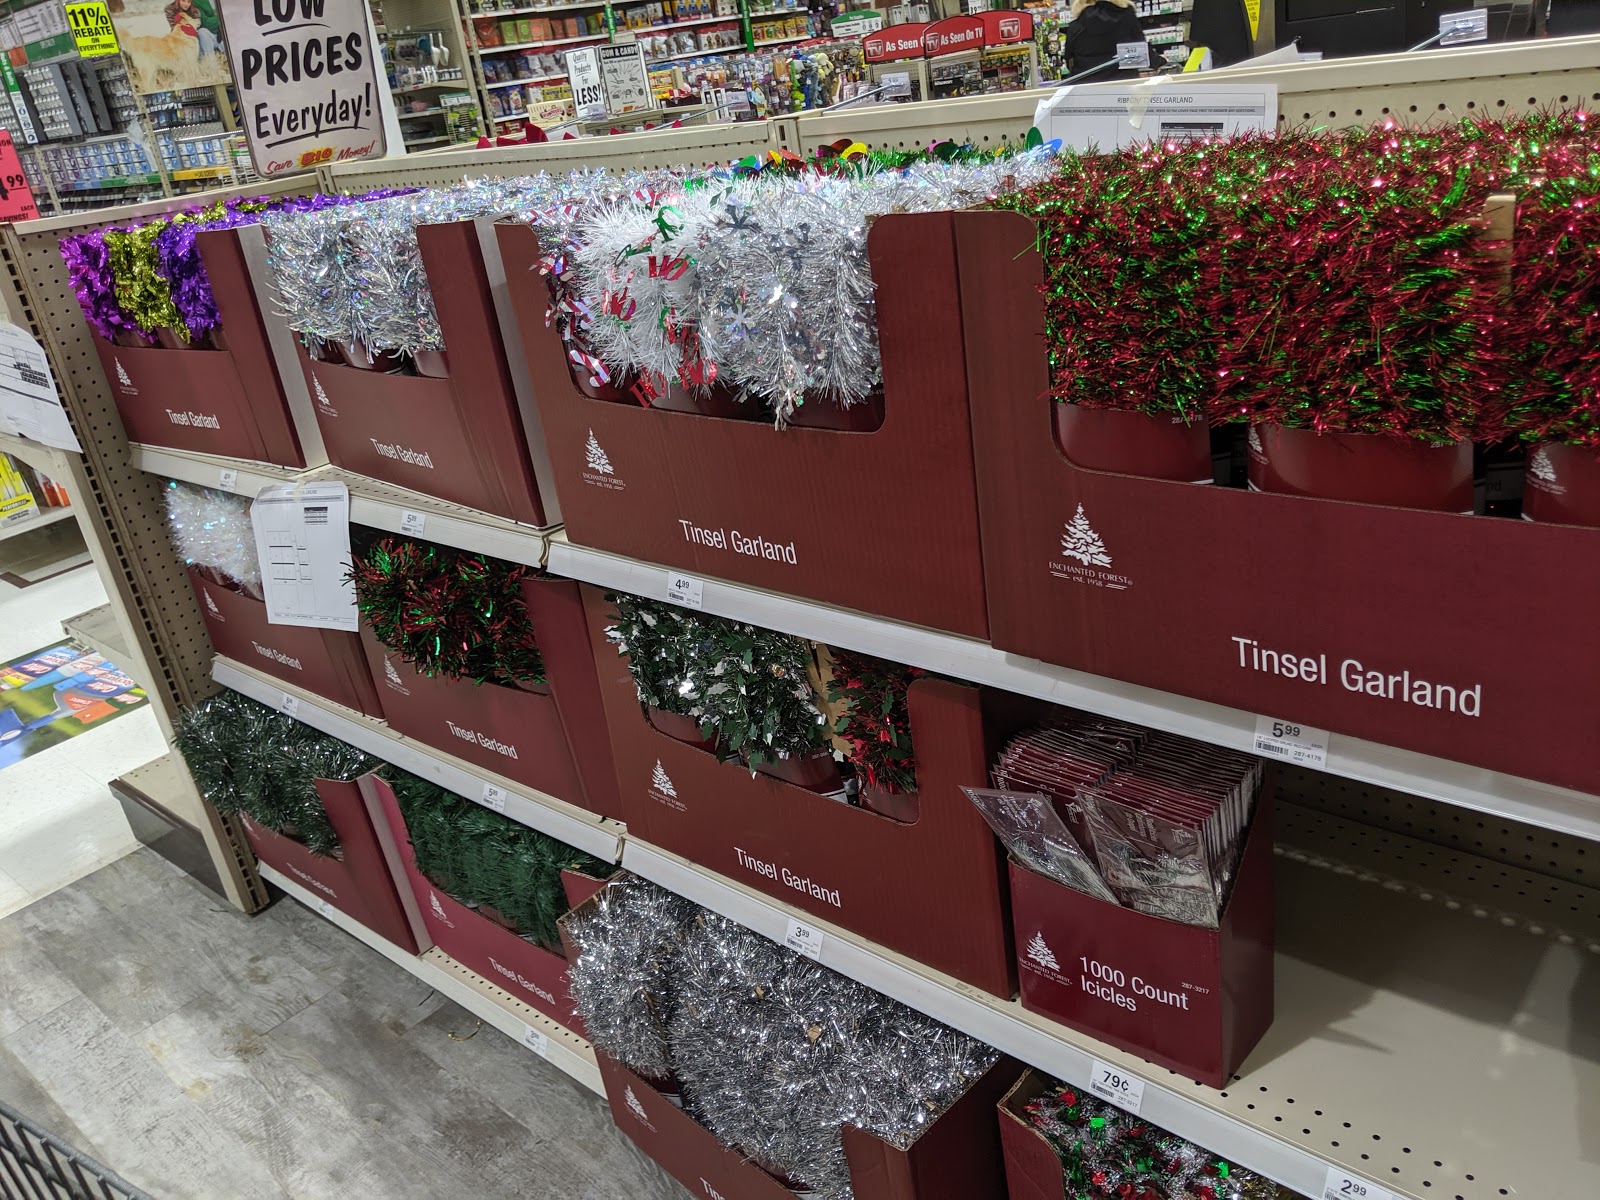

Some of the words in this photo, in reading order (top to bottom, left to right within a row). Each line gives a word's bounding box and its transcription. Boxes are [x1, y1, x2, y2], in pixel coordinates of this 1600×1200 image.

[69, 7, 109, 28] 11%
[253, 0, 326, 27] LOW
[74, 26, 113, 39] REBATE
[940, 34, 949, 46] As
[949, 31, 965, 44] Seen
[966, 29, 974, 40] On
[975, 27, 983, 38] TV
[1001, 26, 1019, 38] TV
[885, 41, 896, 53] As
[898, 39, 918, 51] Seen
[241, 32, 363, 90] PRICES
[576, 84, 601, 106] LESS!
[1163, 96, 1193, 104] GARLAND
[255, 82, 371, 138] Everyday!
[264, 158, 294, 175] Save
[337, 140, 376, 162] Money!
[166, 409, 189, 421] Tinsel
[189, 412, 220, 429] Garland
[370, 437, 399, 460] Tinsel
[396, 445, 434, 469] Garland
[678, 519, 728, 550] Tinsel
[731, 530, 797, 564] Garland
[1049, 561, 1096, 578] ENCHANTED
[1072, 576, 1085, 584] est.
[675, 579, 690, 590] 499
[1231, 636, 1327, 685] Tinsel
[1340, 659, 1481, 718] Garland
[446, 720, 477, 744] Tinsel
[477, 732, 518, 760] Garland
[1272, 722, 1301, 737] 599
[1294, 751, 1322, 761] 287-4178
[734, 846, 778, 880] Tinsel
[781, 867, 842, 908] Garland
[795, 926, 810, 938] 399
[487, 956, 518, 982] Tinsel
[517, 974, 556, 1005] Garland
[1079, 956, 1125, 988] 1000
[1131, 976, 1189, 1011] Count
[1181, 981, 1210, 995] 287-3217
[1081, 975, 1137, 1012] Icicles
[1103, 1070, 1129, 1092] 79¢
[1341, 1179, 1367, 1196] 299
